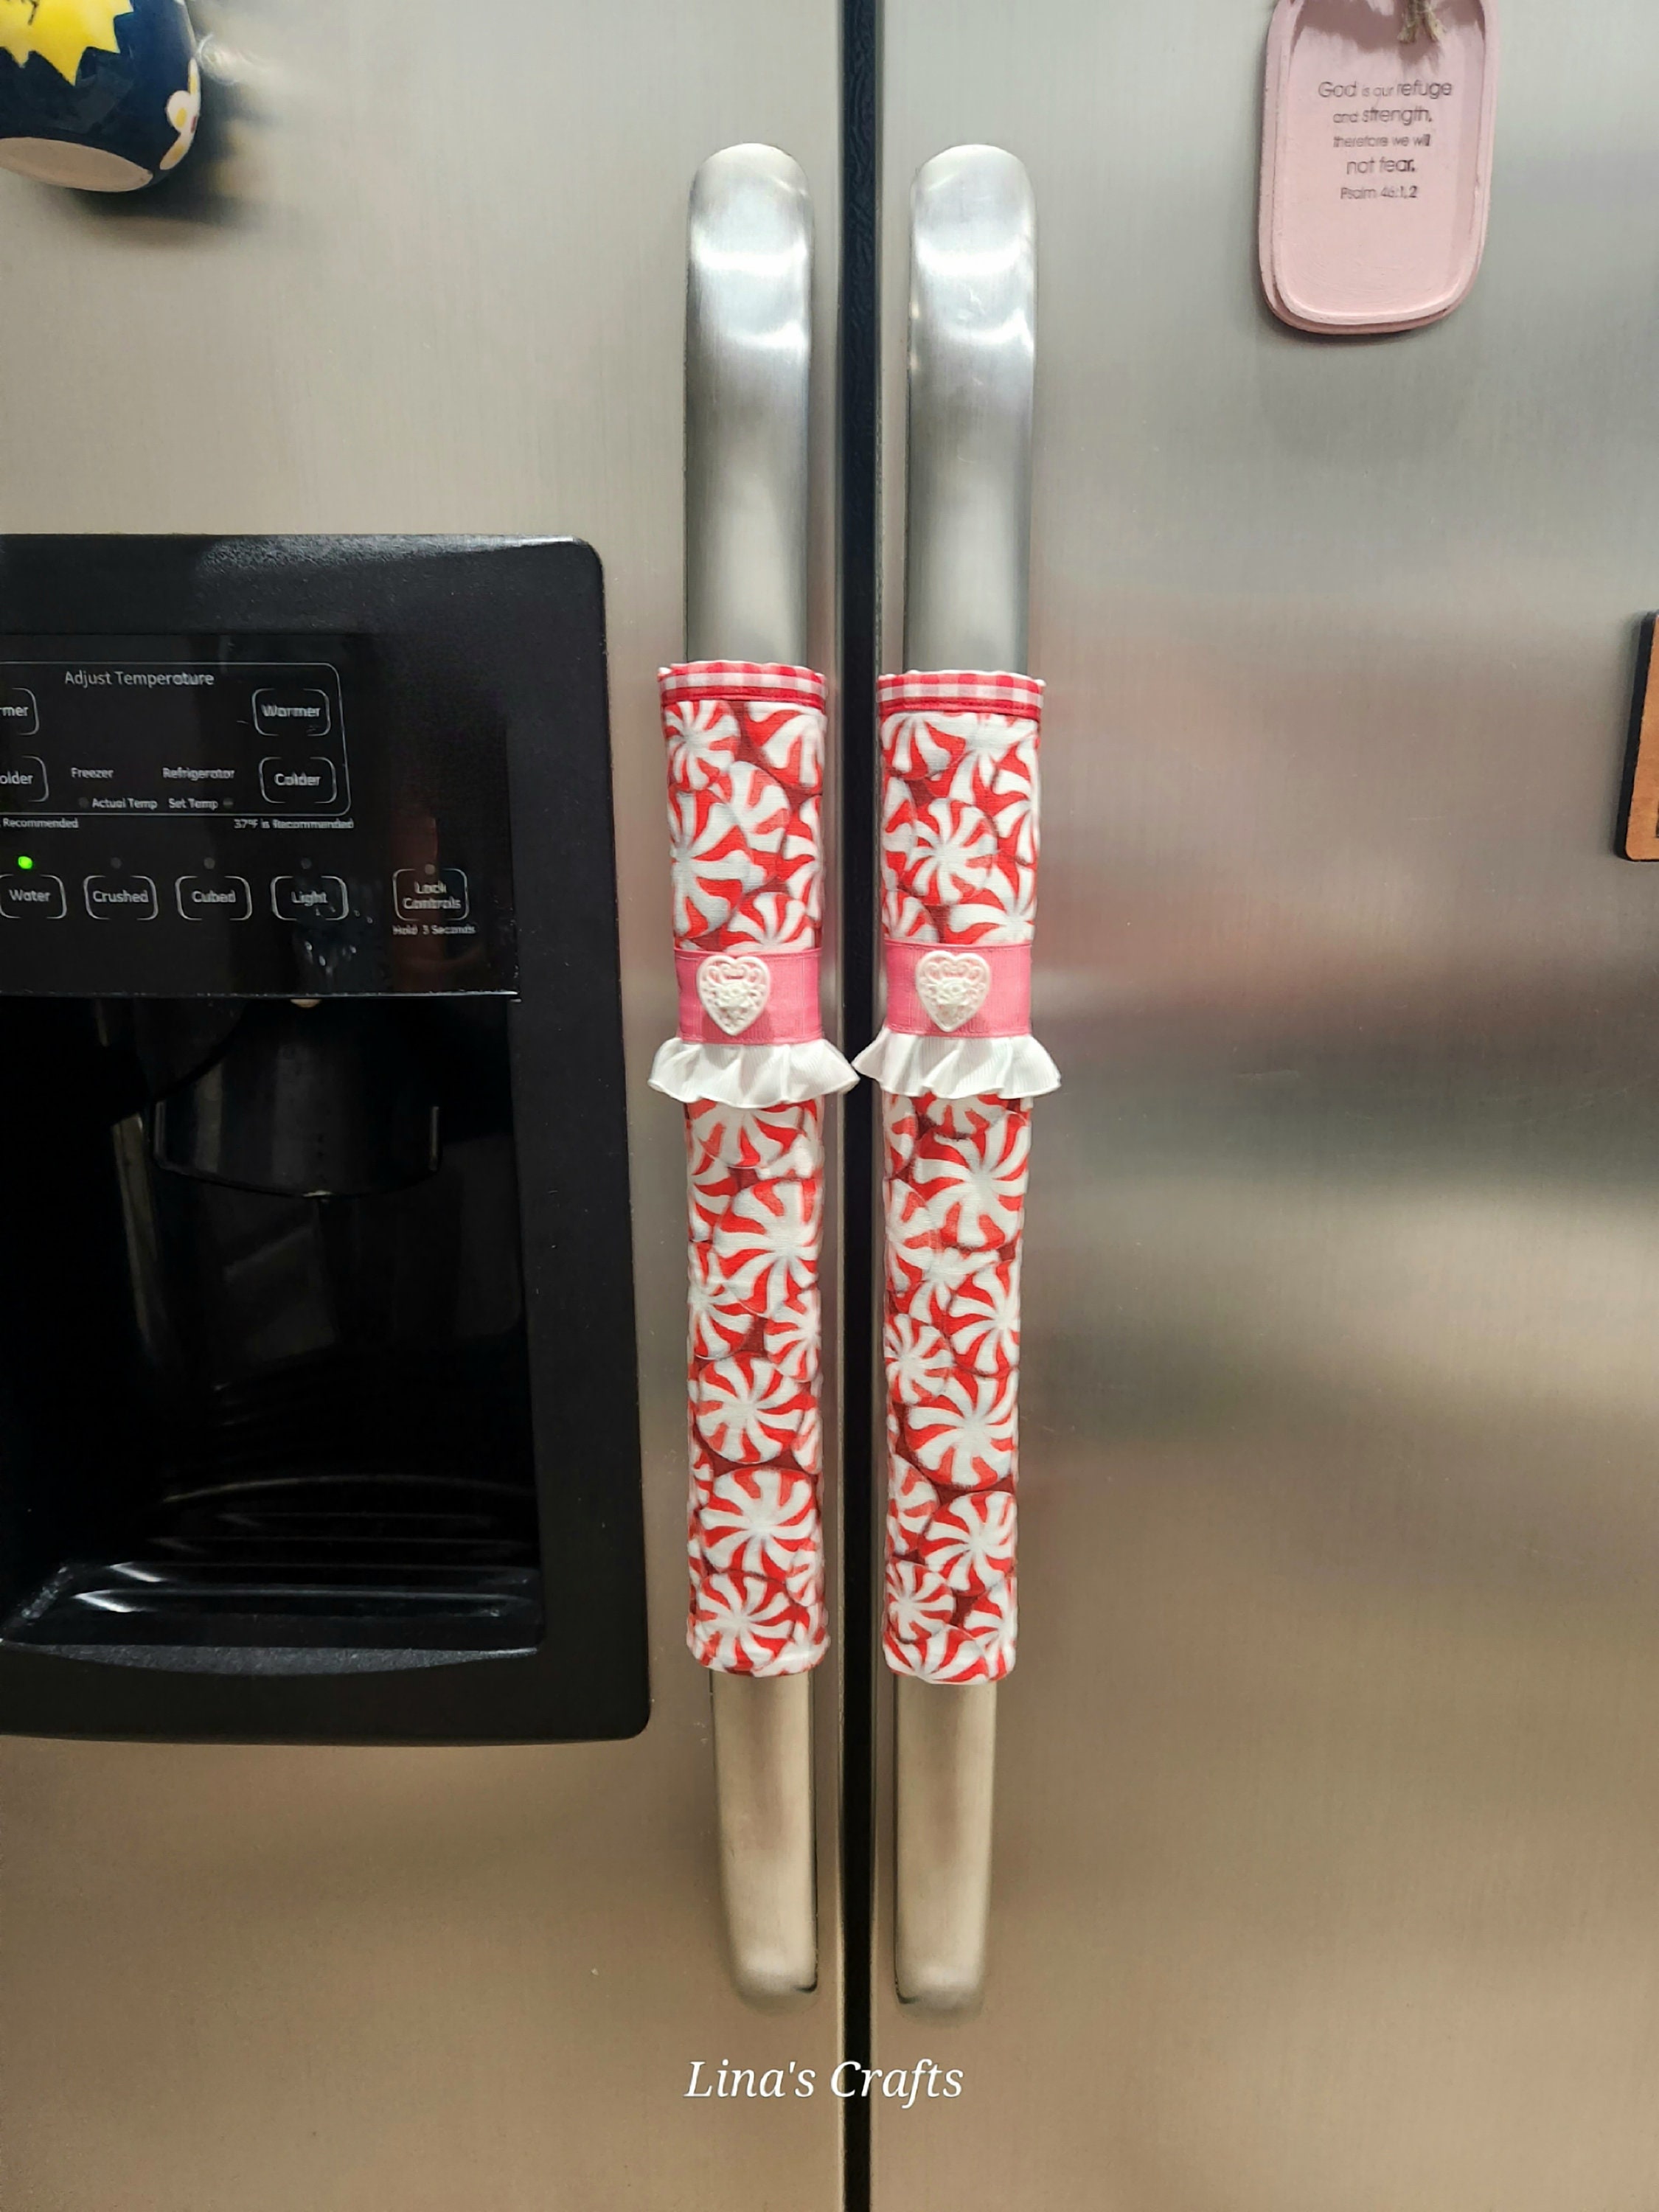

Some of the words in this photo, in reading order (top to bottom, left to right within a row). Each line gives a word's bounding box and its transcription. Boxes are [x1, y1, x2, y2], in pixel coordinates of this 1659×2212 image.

[1318, 80, 1357, 98] God
[1362, 86, 1369, 97] is
[1374, 87, 1394, 97] our
[1397, 80, 1453, 100] refuge
[1333, 111, 1358, 123] and
[1333, 136, 1388, 147] therefore
[1392, 138, 1410, 147] we
[1413, 134, 1431, 147] will
[1346, 158, 1375, 175] not
[1379, 156, 1416, 173] fear.
[1340, 186, 1377, 200] Psalm
[65, 670, 111, 688] Adjust
[114, 671, 215, 688] Temperature
[0, 706, 28, 717] mer
[261, 705, 321, 717] Warmer
[71, 768, 114, 779] Freezer
[162, 768, 235, 781] Refrigerator
[274, 772, 321, 786] Colder
[91, 798, 127, 809] Actual
[128, 798, 159, 810] Temp
[168, 798, 187, 809] Set
[189, 798, 219, 810] Temp
[3, 818, 79, 828] Recommended
[261, 818, 270, 829] is
[272, 818, 354, 829] Recommended
[414, 881, 447, 894] Lock
[9, 889, 51, 902] Water
[92, 890, 149, 902] Crushed
[192, 889, 237, 903] Cubed
[291, 891, 328, 907] Light
[402, 896, 462, 909] Controls
[392, 925, 418, 935] Hold
[422, 925, 430, 935] 3
[431, 924, 476, 935] Seconds
